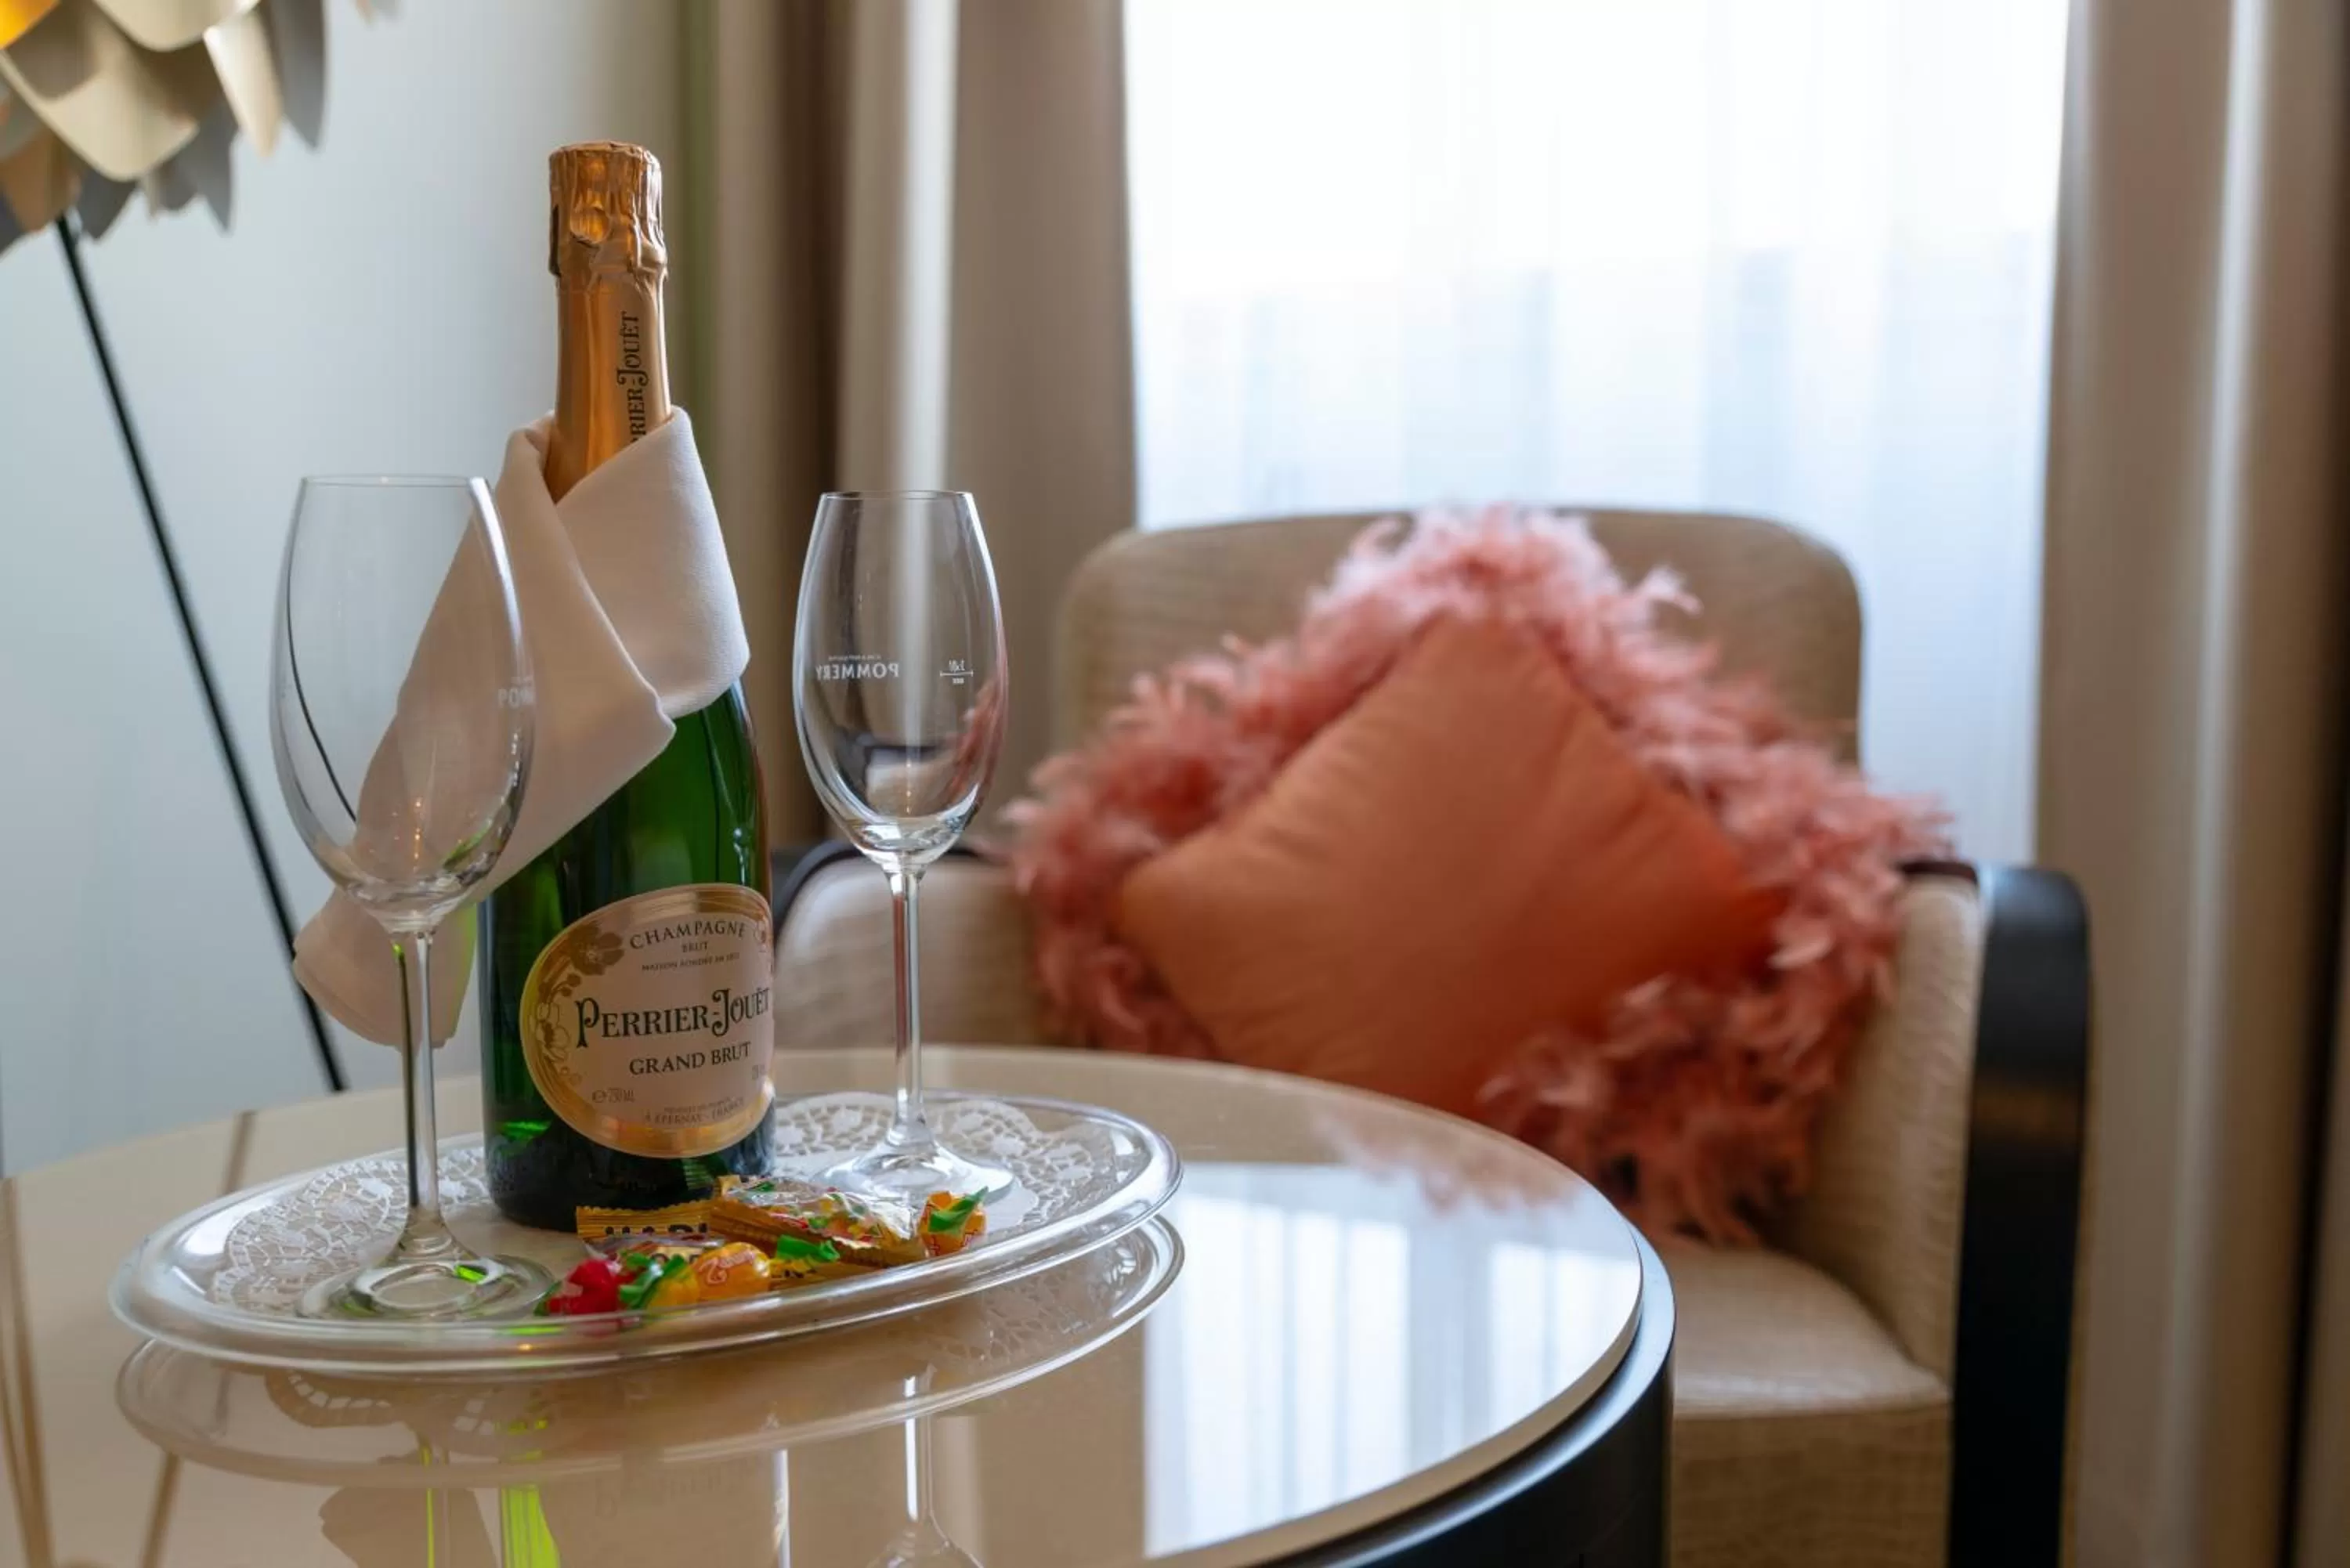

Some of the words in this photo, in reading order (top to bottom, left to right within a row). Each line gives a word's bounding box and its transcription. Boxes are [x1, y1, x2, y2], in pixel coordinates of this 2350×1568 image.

[630, 920, 745, 949] CHAMPAGNE
[682, 941, 708, 952] BRUT
[629, 1051, 706, 1076] GRAND
[711, 1042, 751, 1066] BRUT
